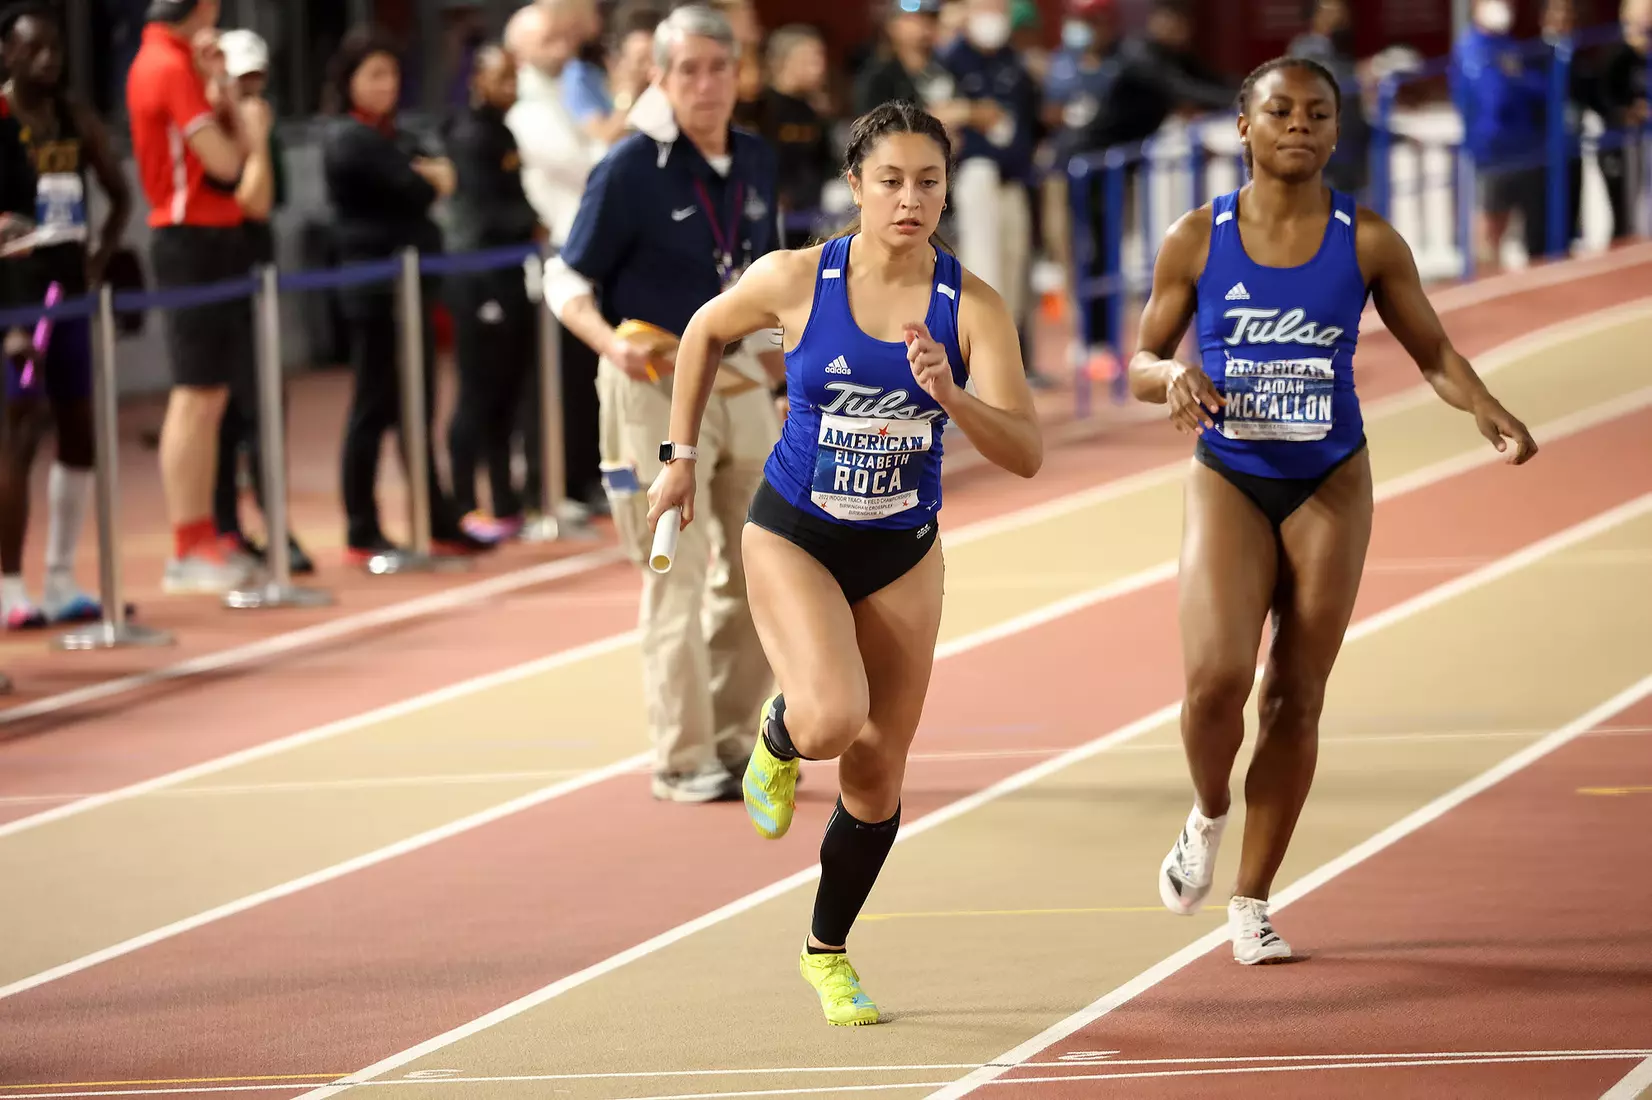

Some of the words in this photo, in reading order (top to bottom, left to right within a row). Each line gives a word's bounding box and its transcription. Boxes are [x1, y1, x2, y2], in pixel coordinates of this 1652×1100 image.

[1223, 307, 1344, 346] Tulsa
[825, 367, 851, 375] adidas
[1254, 379, 1305, 394] JAIDAH
[1225, 393, 1331, 421] MCCALLON
[823, 428, 923, 451] AMERICAN
[834, 449, 910, 470] ELIZABETH
[834, 466, 902, 494] ROCA
[847, 496, 862, 504] TRACK
